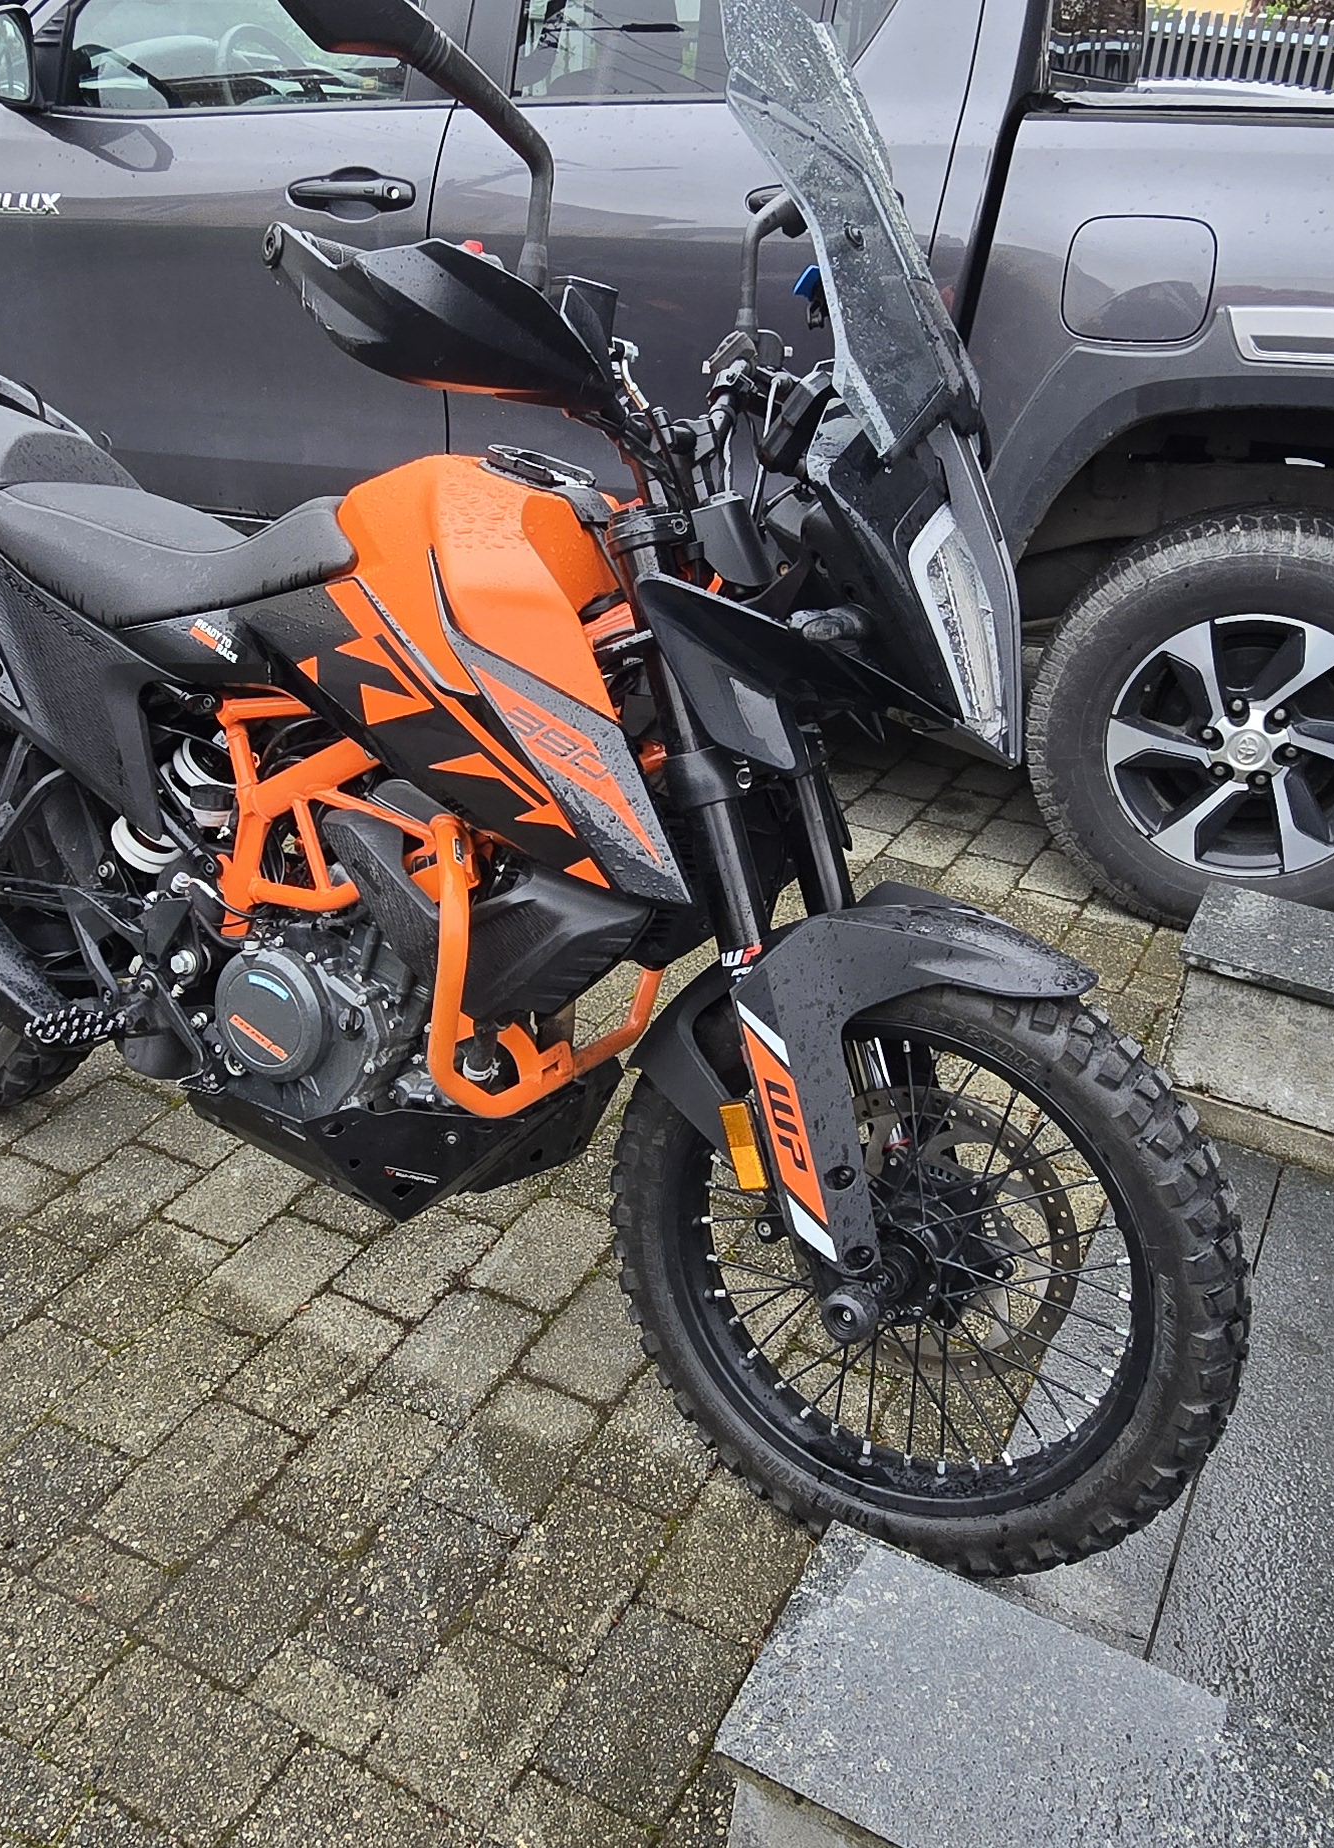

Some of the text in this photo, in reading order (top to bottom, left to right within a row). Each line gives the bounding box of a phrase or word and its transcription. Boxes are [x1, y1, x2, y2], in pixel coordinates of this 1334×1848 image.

[194, 618, 233, 649] READY TO
[214, 643, 239, 664] RACE
[505, 705, 609, 780] 390
[720, 944, 763, 967] WP
[763, 1078, 809, 1173] WP
